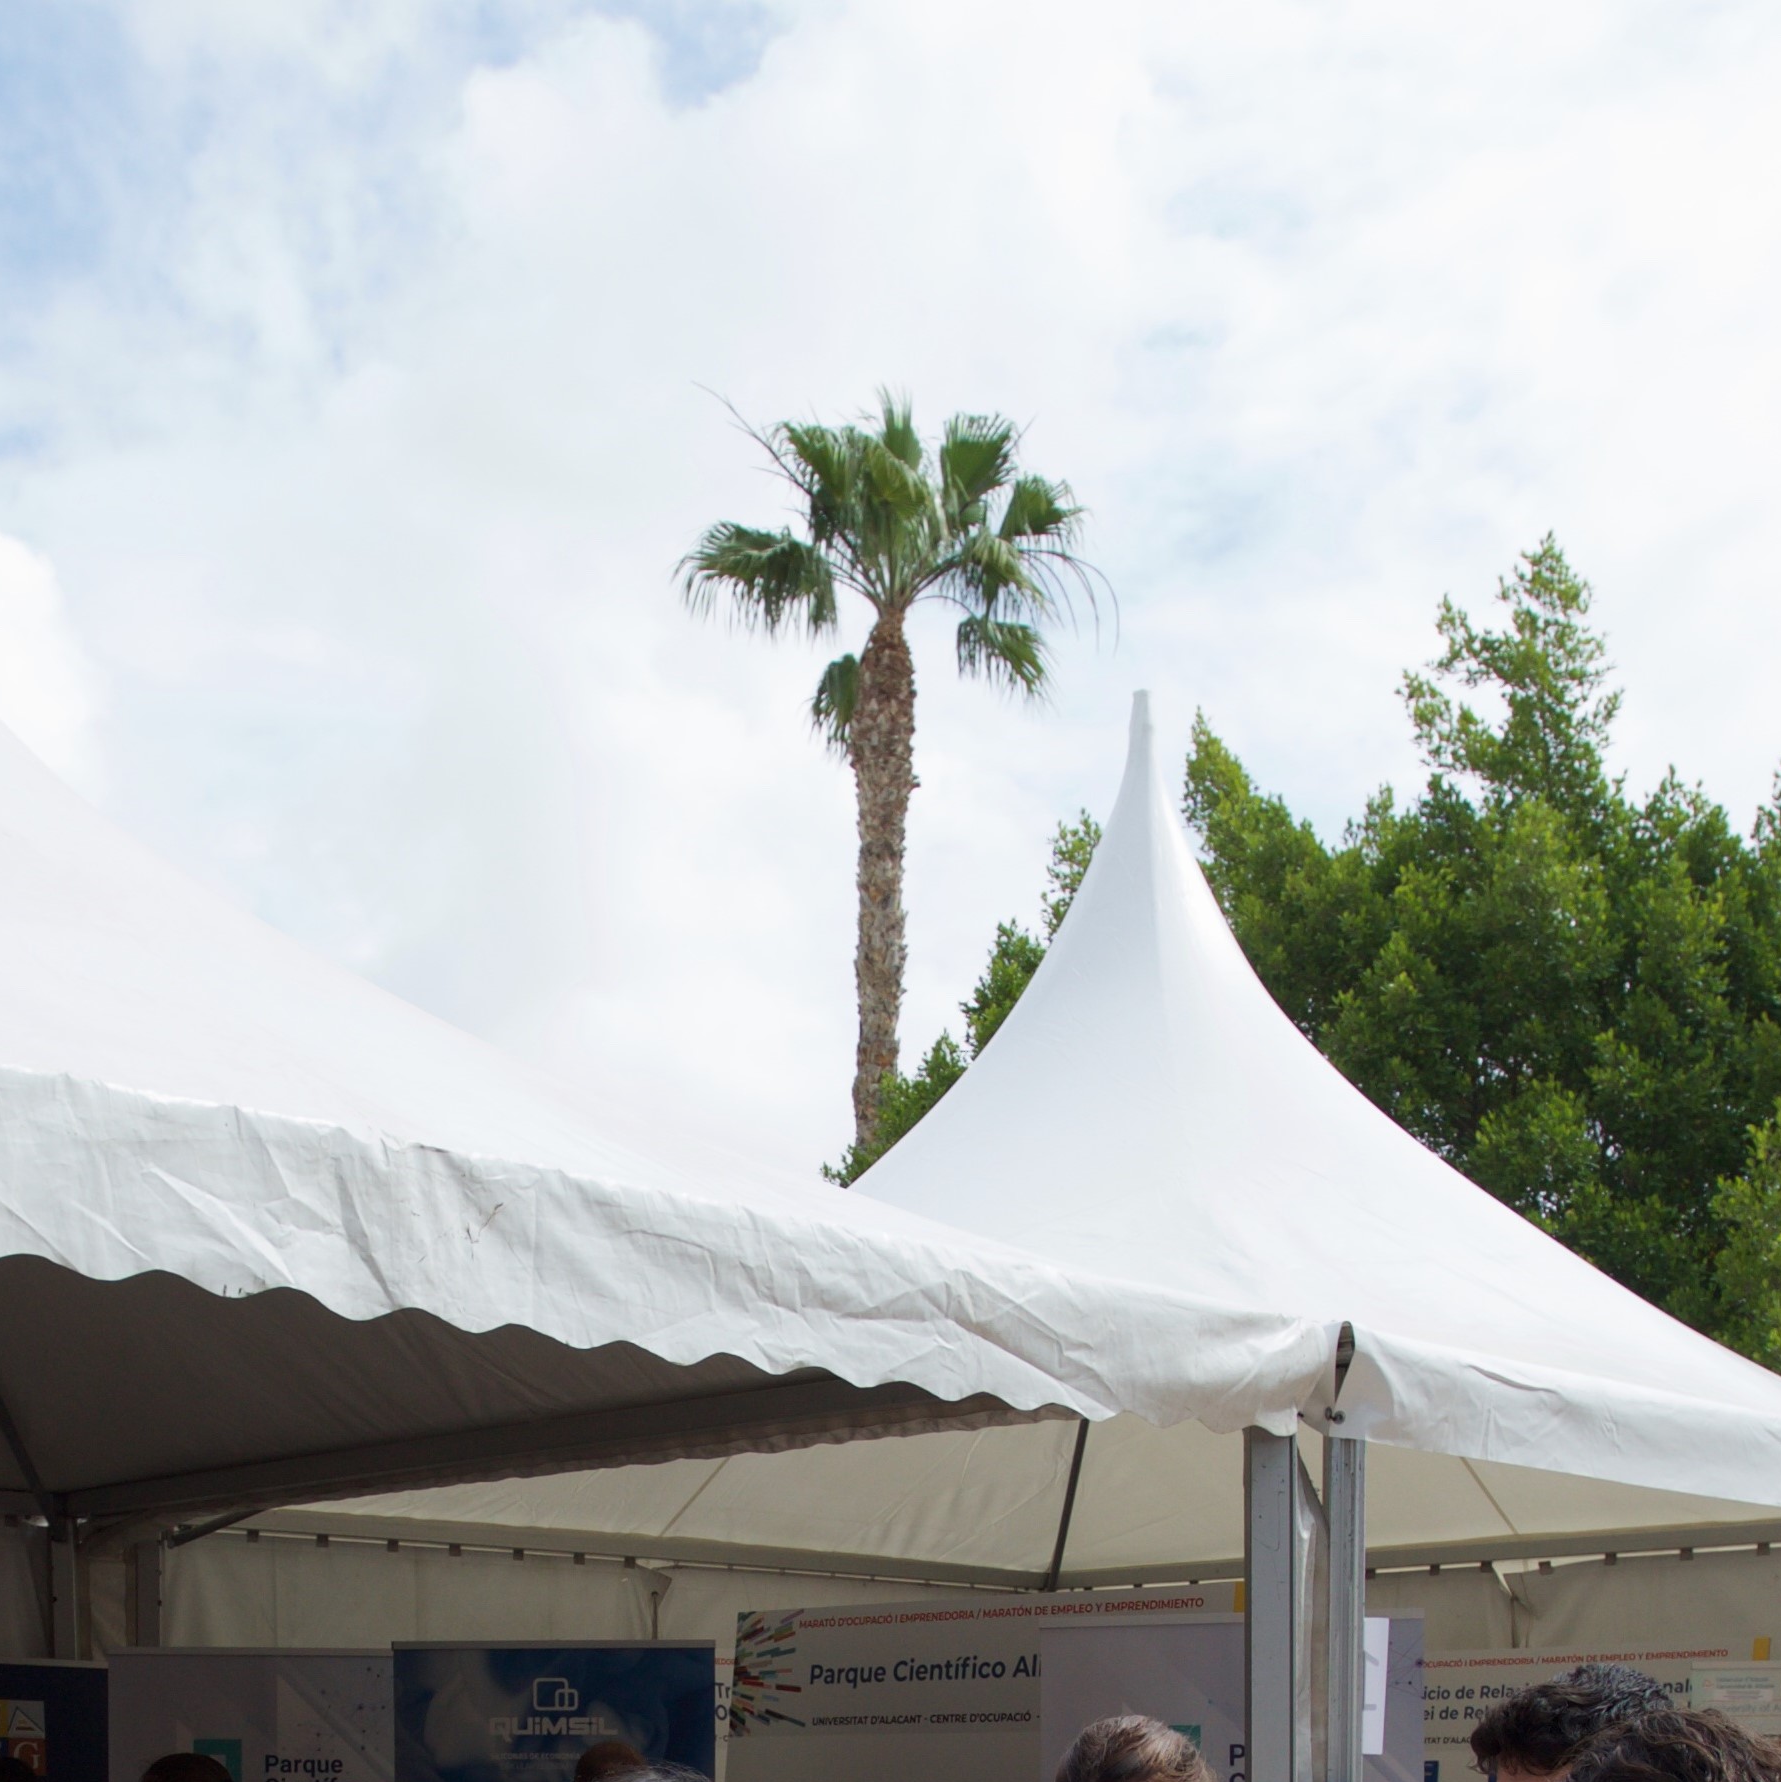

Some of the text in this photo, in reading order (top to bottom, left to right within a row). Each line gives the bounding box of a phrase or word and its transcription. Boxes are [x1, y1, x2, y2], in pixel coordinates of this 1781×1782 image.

[799, 1617, 835, 1629] MARATÓ
[900, 1610, 974, 1623] EMPRENEDORIA
[983, 1606, 1032, 1618] MARATÓN
[1035, 1606, 1048, 1615] DE
[1051, 1604, 1093, 1614] EMPLEO
[1096, 1604, 1101, 1612] Y
[1105, 1598, 1203, 1612] EMPRENDIMIENTO
[810, 1655, 1005, 1689] Parque Científico
[1456, 1686, 1474, 1699] de
[812, 1710, 1031, 1725] UNIVERSITAT D'ALACANT CENTRE D'OCUPACIÓ
[1439, 1707, 1459, 1720] de
[265, 1755, 342, 1777] Parque
